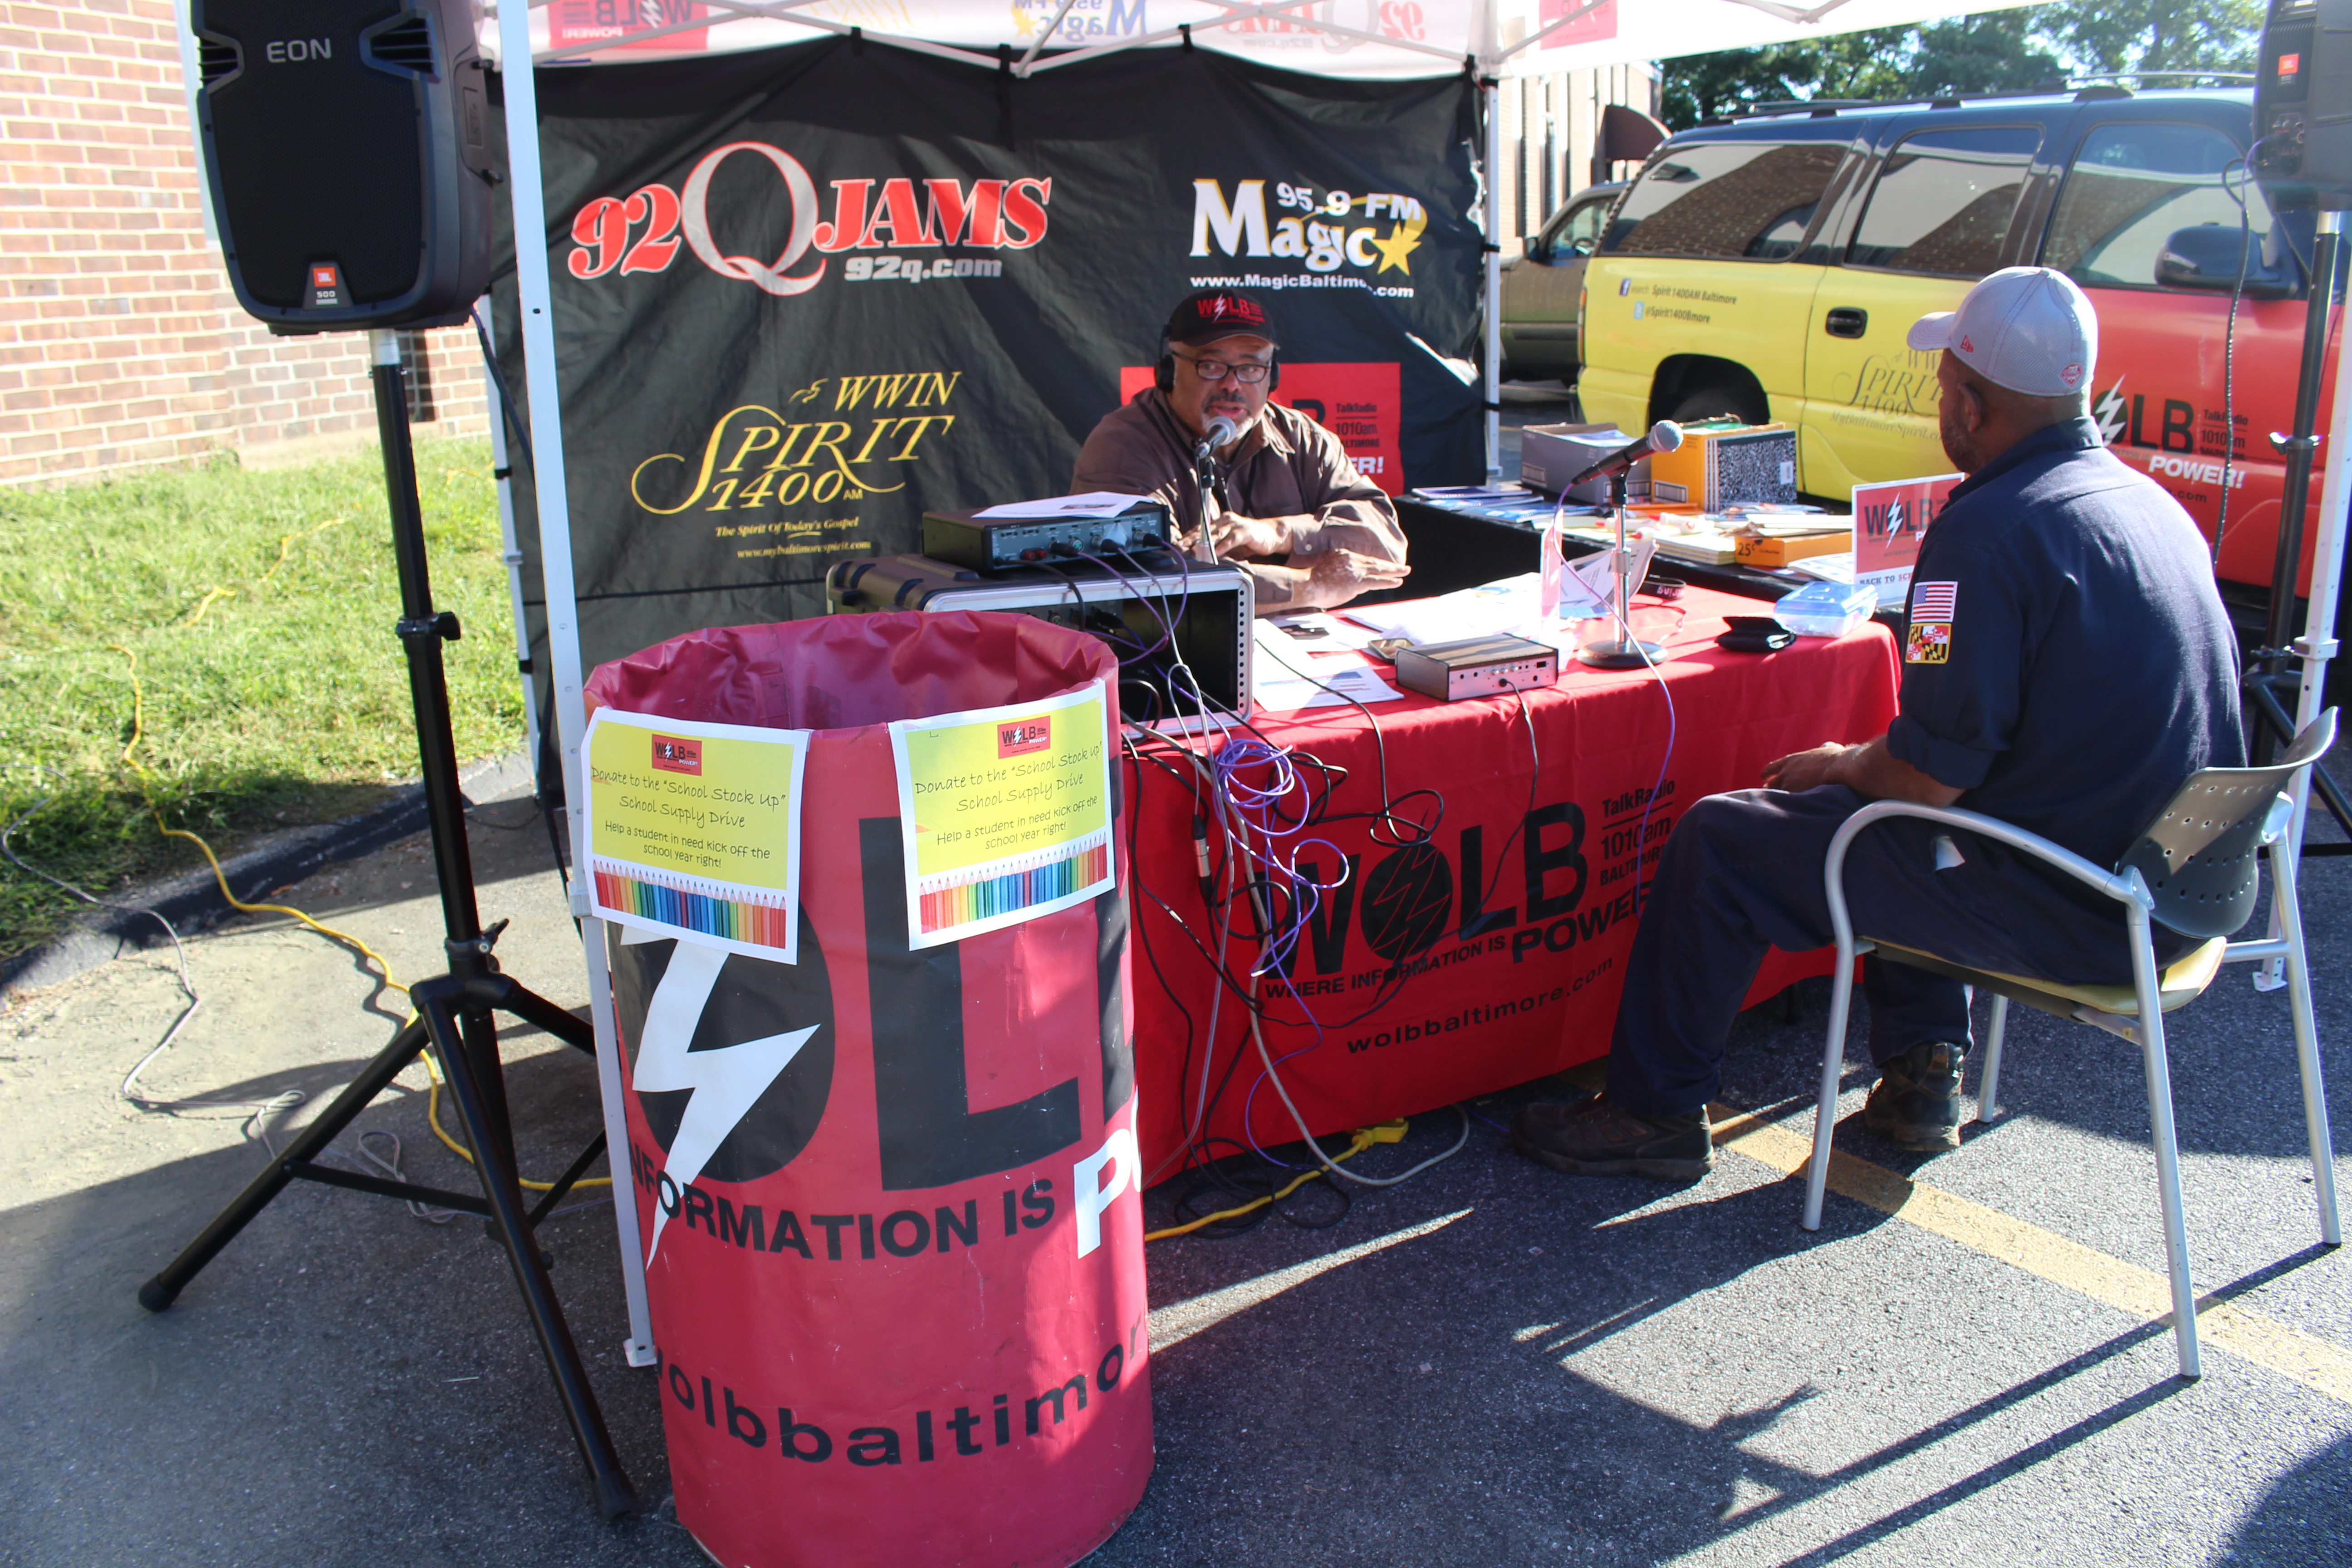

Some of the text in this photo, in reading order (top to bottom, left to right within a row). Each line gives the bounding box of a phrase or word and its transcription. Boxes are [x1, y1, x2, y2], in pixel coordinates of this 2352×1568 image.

[266, 38, 332, 63] EON
[1276, 182, 1421, 221] 95.9 FM
[844, 255, 1002, 283] 92q.com
[316, 290, 336, 298] 500
[1652, 284, 1671, 298] Spirit
[1702, 291, 1738, 304] Baltimore
[834, 372, 962, 411] WWIN
[1335, 422, 1378, 435] 1010am
[706, 466, 863, 511] 1400 AM
[715, 516, 859, 537] The Spirit Of Today's Gospel
[1884, 575, 1895, 583] TO
[655, 742, 686, 760] WOLB
[1002, 726, 1036, 744] WOLB
[592, 764, 627, 784] Donate
[630, 774, 640, 787] to
[643, 775, 660, 791] the
[663, 779, 708, 799] "School
[711, 788, 755, 805] Stock
[915, 779, 966, 795] Donate
[970, 773, 983, 786] to
[987, 769, 1007, 782] the
[1011, 758, 1055, 777] "School
[1058, 749, 1088, 767] Stock
[956, 773, 1083, 812] School Supply Drive
[619, 796, 745, 828] School Supply Drive
[937, 795, 1097, 846] Help a student in need kick off the
[605, 820, 770, 859] Help a student in need kick off the
[985, 821, 1066, 849] school year right!
[643, 844, 721, 868] school year right!
[1245, 801, 1589, 980] WOLB
[1264, 977, 1345, 998] WHERE
[1352, 940, 1482, 990] INFORMATION
[1489, 936, 1506, 951] IS
[1347, 958, 1612, 1054] wolbbaltimore.com
[632, 1142, 979, 1261] NFORMATION
[1004, 1179, 1055, 1237] IS
